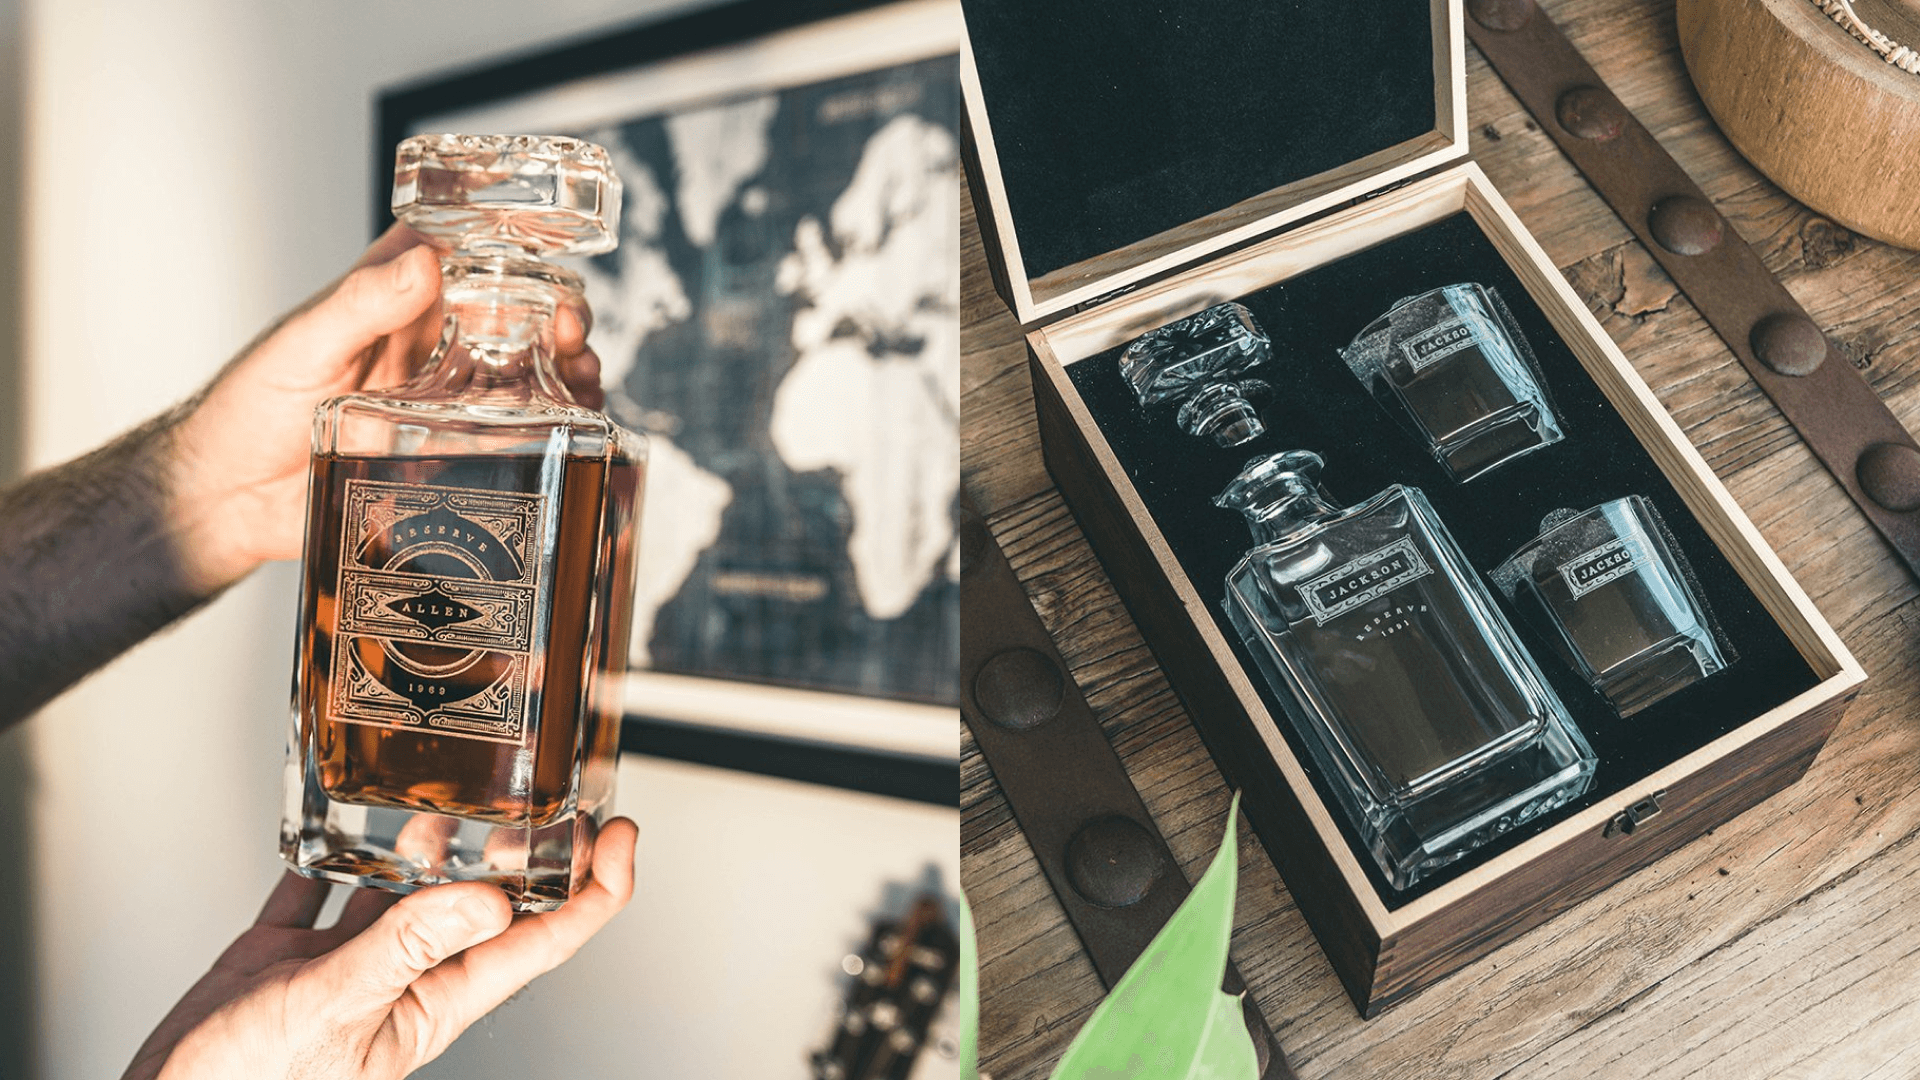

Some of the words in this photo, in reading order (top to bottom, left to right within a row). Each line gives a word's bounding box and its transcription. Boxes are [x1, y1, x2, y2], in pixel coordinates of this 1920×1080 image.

[1420, 327, 1468, 354] JACKSO
[394, 525, 488, 553] RESERVE
[1580, 549, 1631, 580] JACKSO
[1329, 559, 1402, 600] JACKSON
[402, 602, 468, 618] ALLEN
